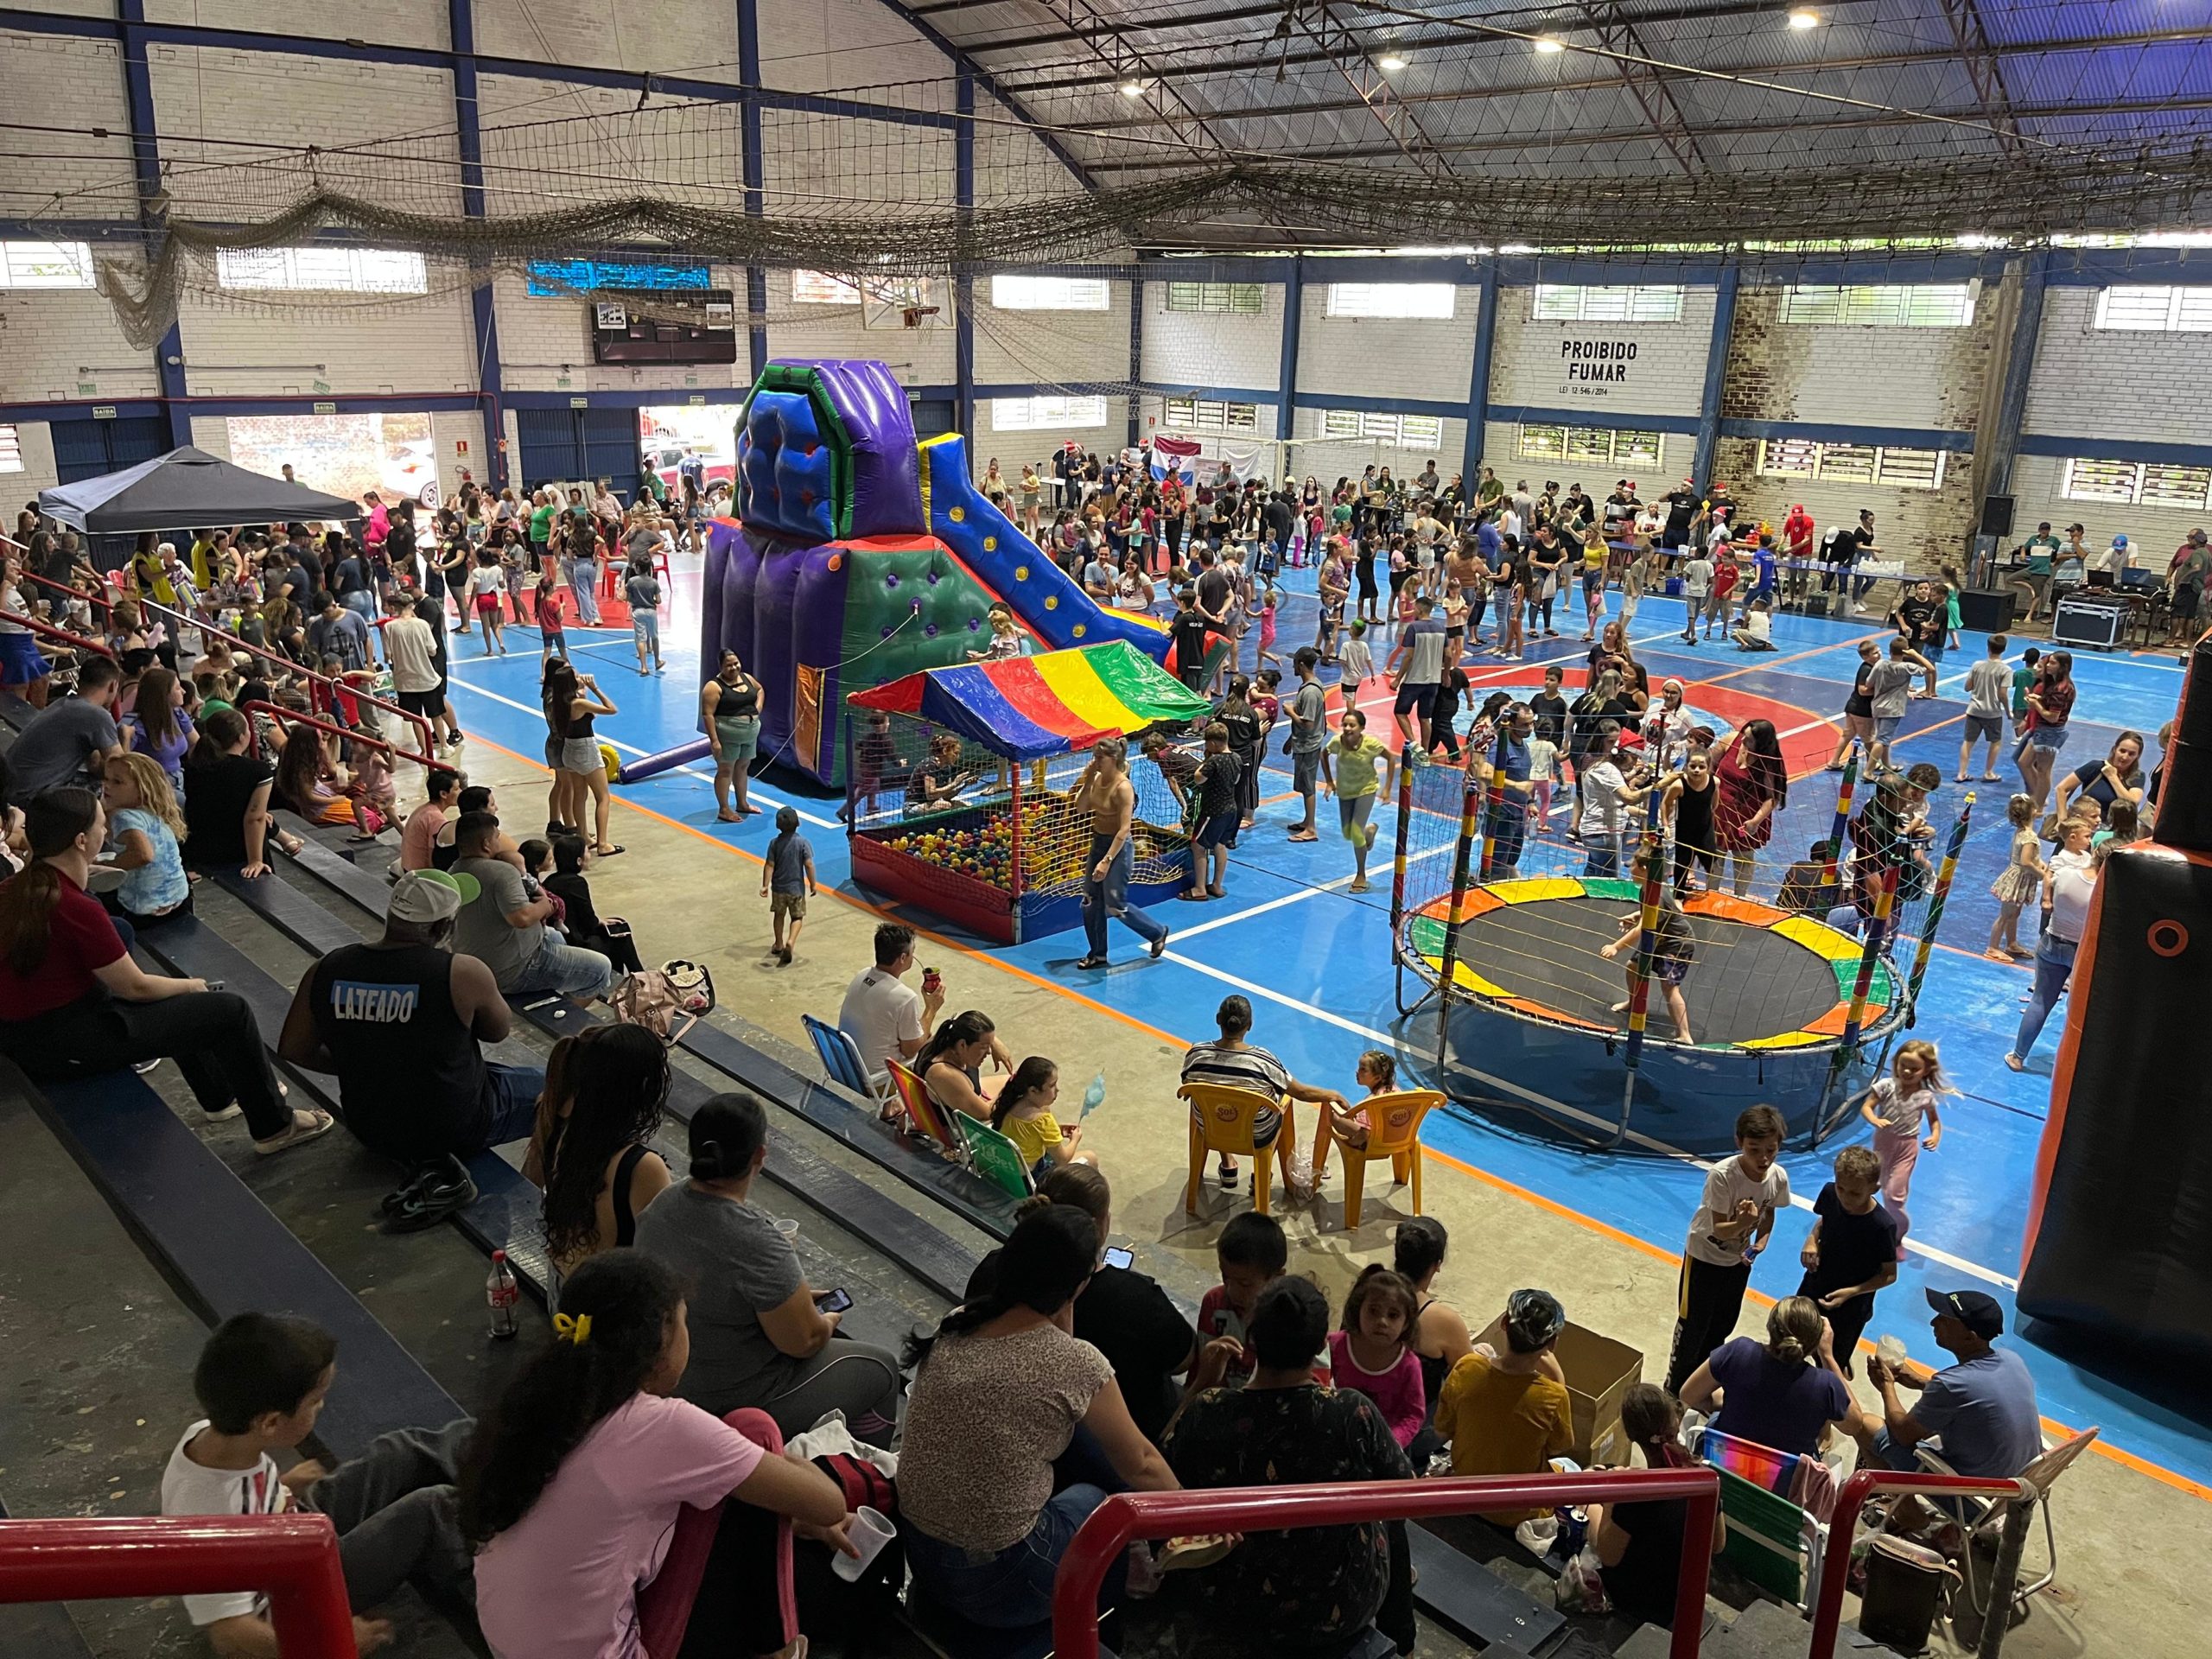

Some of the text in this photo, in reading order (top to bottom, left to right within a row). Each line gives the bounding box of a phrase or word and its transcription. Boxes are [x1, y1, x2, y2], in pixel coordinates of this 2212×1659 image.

[1561, 340, 1637, 360] PROIBIDO
[1568, 363, 1626, 382] FUMAR
[334, 985, 415, 1023] LAJEADO
